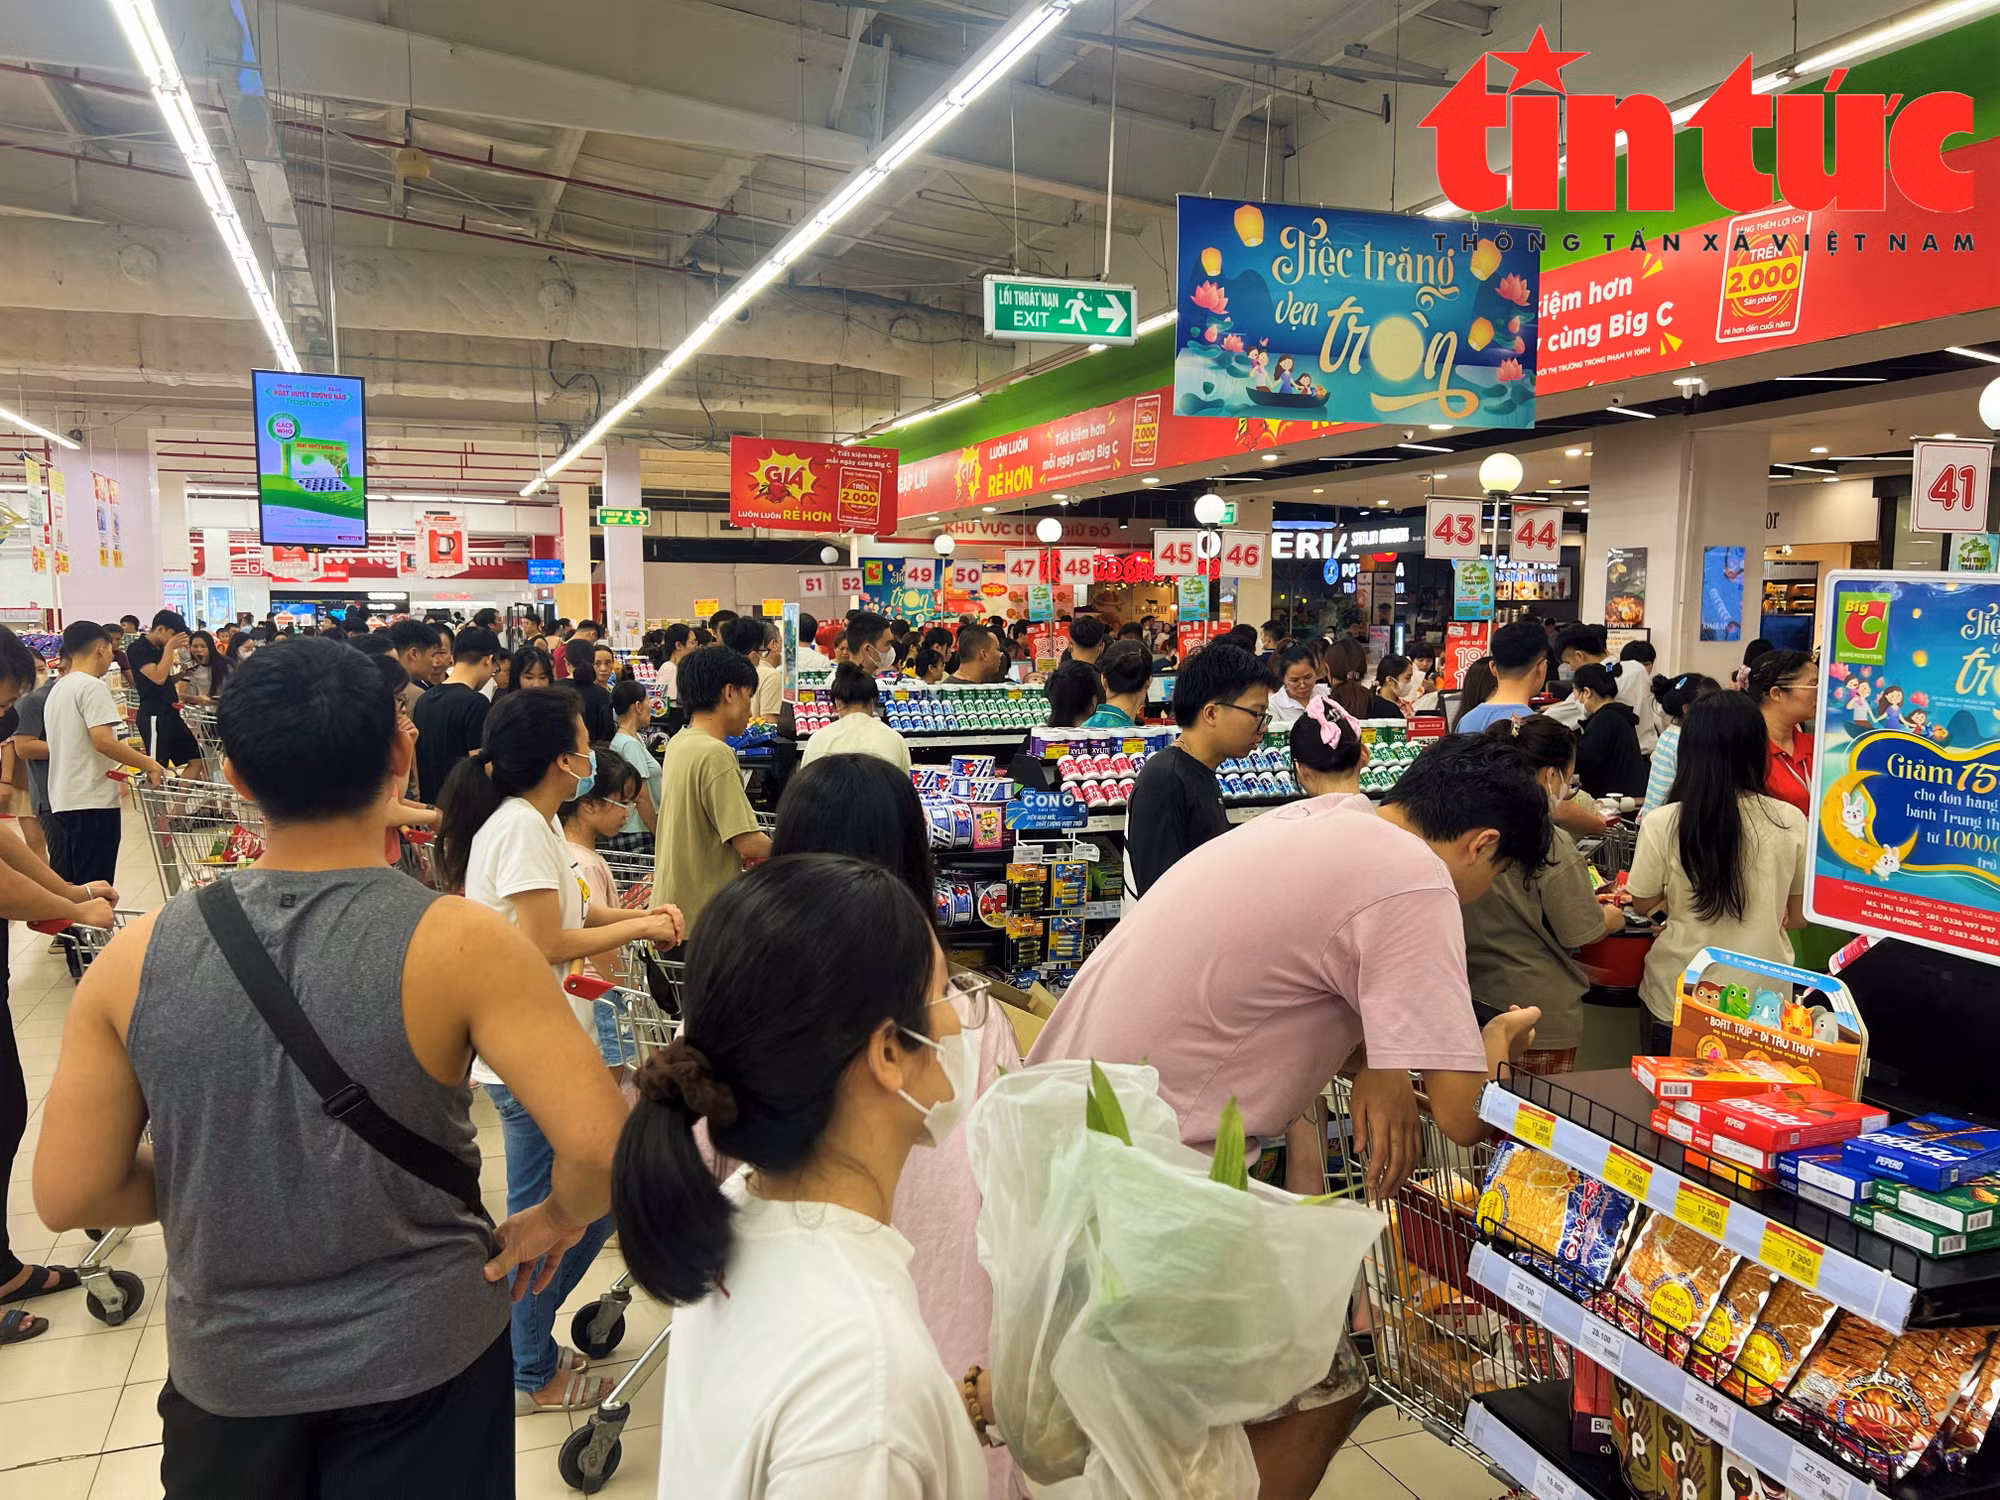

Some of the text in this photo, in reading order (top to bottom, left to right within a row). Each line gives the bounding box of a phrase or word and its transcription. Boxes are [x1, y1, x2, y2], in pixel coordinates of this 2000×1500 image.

[1756, 220, 1777, 231] THÊM
[1750, 243, 1784, 262] TRÊN
[1272, 217, 1459, 312] Tiệc trăng
[1728, 262, 1797, 295] 2.000
[999, 285, 1059, 311] LỐI THOÁT NẠN
[1589, 275, 1633, 305] hơn
[1013, 311, 1050, 327] EXIT
[1274, 290, 1318, 331] vẹn
[1548, 301, 1674, 353] cùng Big C
[1318, 295, 1479, 420] tròn
[1584, 356, 1606, 367] TRONG
[1626, 350, 1633, 358] VI
[1634, 346, 1651, 357] 10KM
[286, 397, 330, 407] Traphaco
[1055, 421, 1106, 447] Tiết kiệm hơn
[989, 436, 1028, 460] LUÔN LUÔN
[1057, 453, 1075, 471] ngày
[1076, 447, 1095, 465] cùng
[1096, 443, 1111, 461] Big
[1111, 439, 1118, 455] C
[988, 463, 1003, 498] RẺ
[1004, 465, 1034, 494] HƠN
[1927, 463, 1977, 512] 41
[842, 491, 877, 504] 2.000
[738, 509, 759, 519] LUÔN
[760, 511, 781, 520] LUÔN
[783, 506, 800, 520] RẺ
[802, 510, 832, 523] HƠN
[944, 522, 975, 534] KHU
[980, 522, 1011, 537] VỰC
[1432, 513, 1475, 546] 43
[1515, 518, 1557, 551] 44
[1159, 541, 1194, 566] 45
[1225, 543, 1260, 567] 46
[907, 567, 932, 582] 49
[955, 568, 980, 583] 50
[1010, 558, 1036, 578] 47
[1064, 558, 1091, 576] 48
[805, 577, 822, 592] 51
[842, 576, 861, 591] 52
[1844, 600, 1869, 615] Big
[1839, 651, 1882, 660] SUPERCENTER
[1887, 753, 2000, 794] Giảm 15
[1914, 789, 1999, 814] cho đơn hàng
[1906, 803, 1982, 831] bánh Trung
[1927, 829, 1940, 844] từ
[1843, 884, 1864, 893] KHÁCH
[1962, 908, 1973, 916] VUI
[1866, 900, 1878, 909] MS.
[1880, 901, 1894, 910] THU
[1895, 904, 1920, 916] TRANG
[1943, 916, 1962, 926] 0336
[1964, 920, 1979, 930] 497
[1892, 916, 1923, 929] PHƯƠNG
[1948, 929, 1968, 939] 0383
[1709, 1015, 1815, 1058] BOAT TRIP ĐI TÀU THUỶ
[1724, 1116, 1746, 1131] PEPERO
[1694, 1135, 1711, 1148] PEPERO
[1857, 1133, 1969, 1162] PEPERO
[1778, 1162, 1797, 1175] PEPERO
[1875, 1155, 1905, 1171] PEPERO
[1623, 1167, 1643, 1184] 17.900
[1875, 1191, 1897, 1205] PEPERO
[1698, 1204, 1720, 1220] 17.900
[1853, 1213, 1873, 1227] PEPERO
[1786, 1248, 1811, 1267] 17.900
[1695, 1394, 1719, 1413] 28.100
[1803, 1461, 1831, 1486] 27.900
